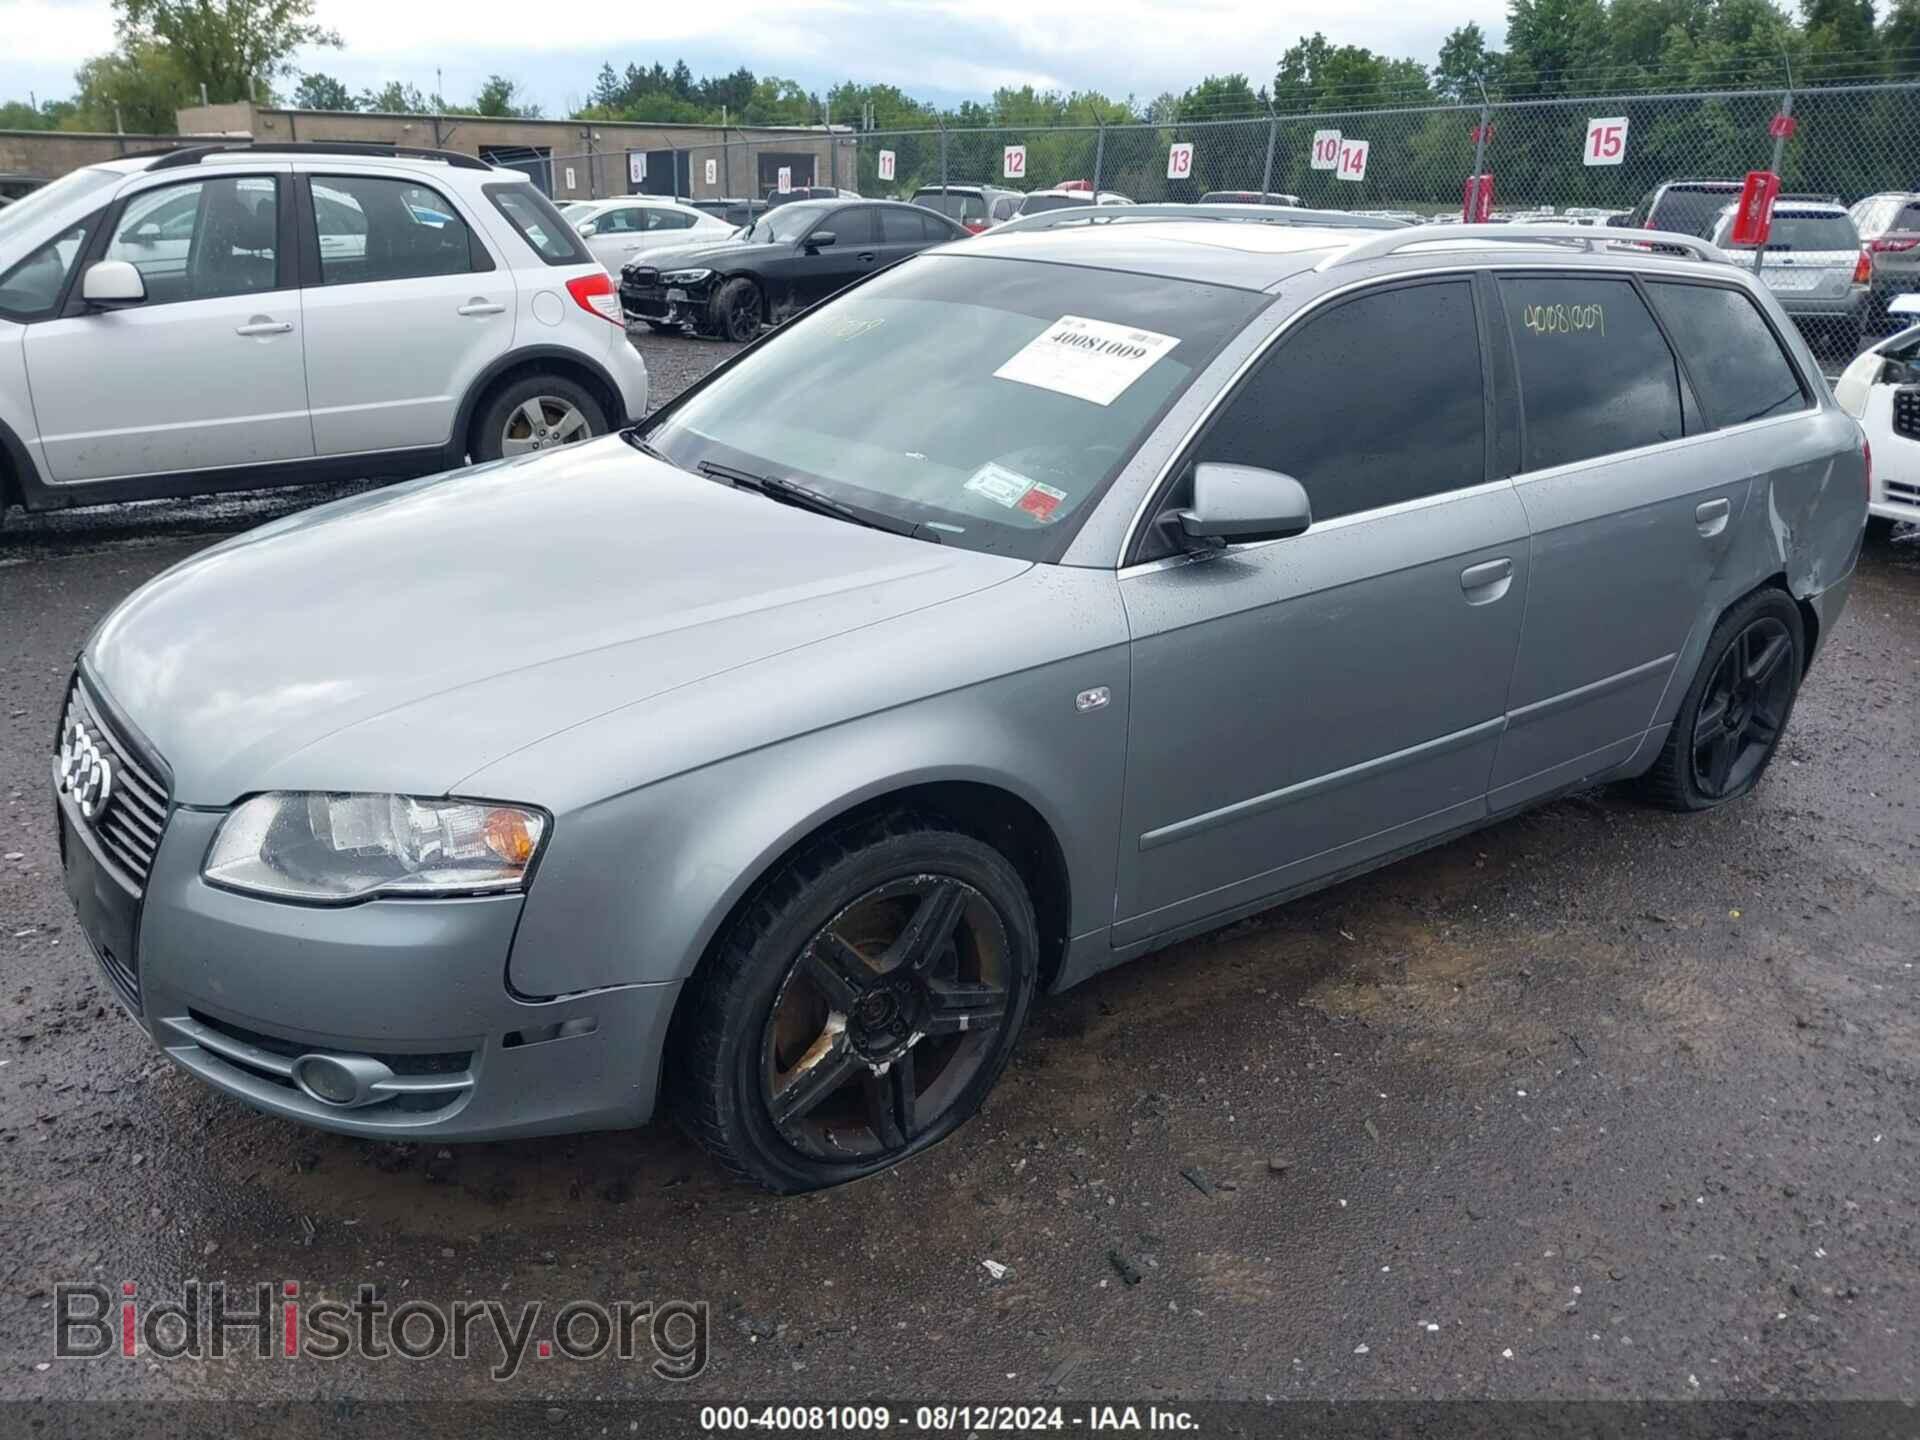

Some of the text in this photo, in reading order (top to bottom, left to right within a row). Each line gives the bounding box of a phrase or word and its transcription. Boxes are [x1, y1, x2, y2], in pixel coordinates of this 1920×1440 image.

[1315, 139, 1336, 161] 10
[1590, 127, 1622, 157] 15
[882, 157, 892, 175] 11
[1006, 153, 1023, 172] 12
[1171, 150, 1189, 173] 13
[1342, 147, 1363, 174] 14
[780, 174, 790, 191] 10
[1524, 303, 1605, 336] 40081009
[1052, 331, 1147, 360] 40081009
